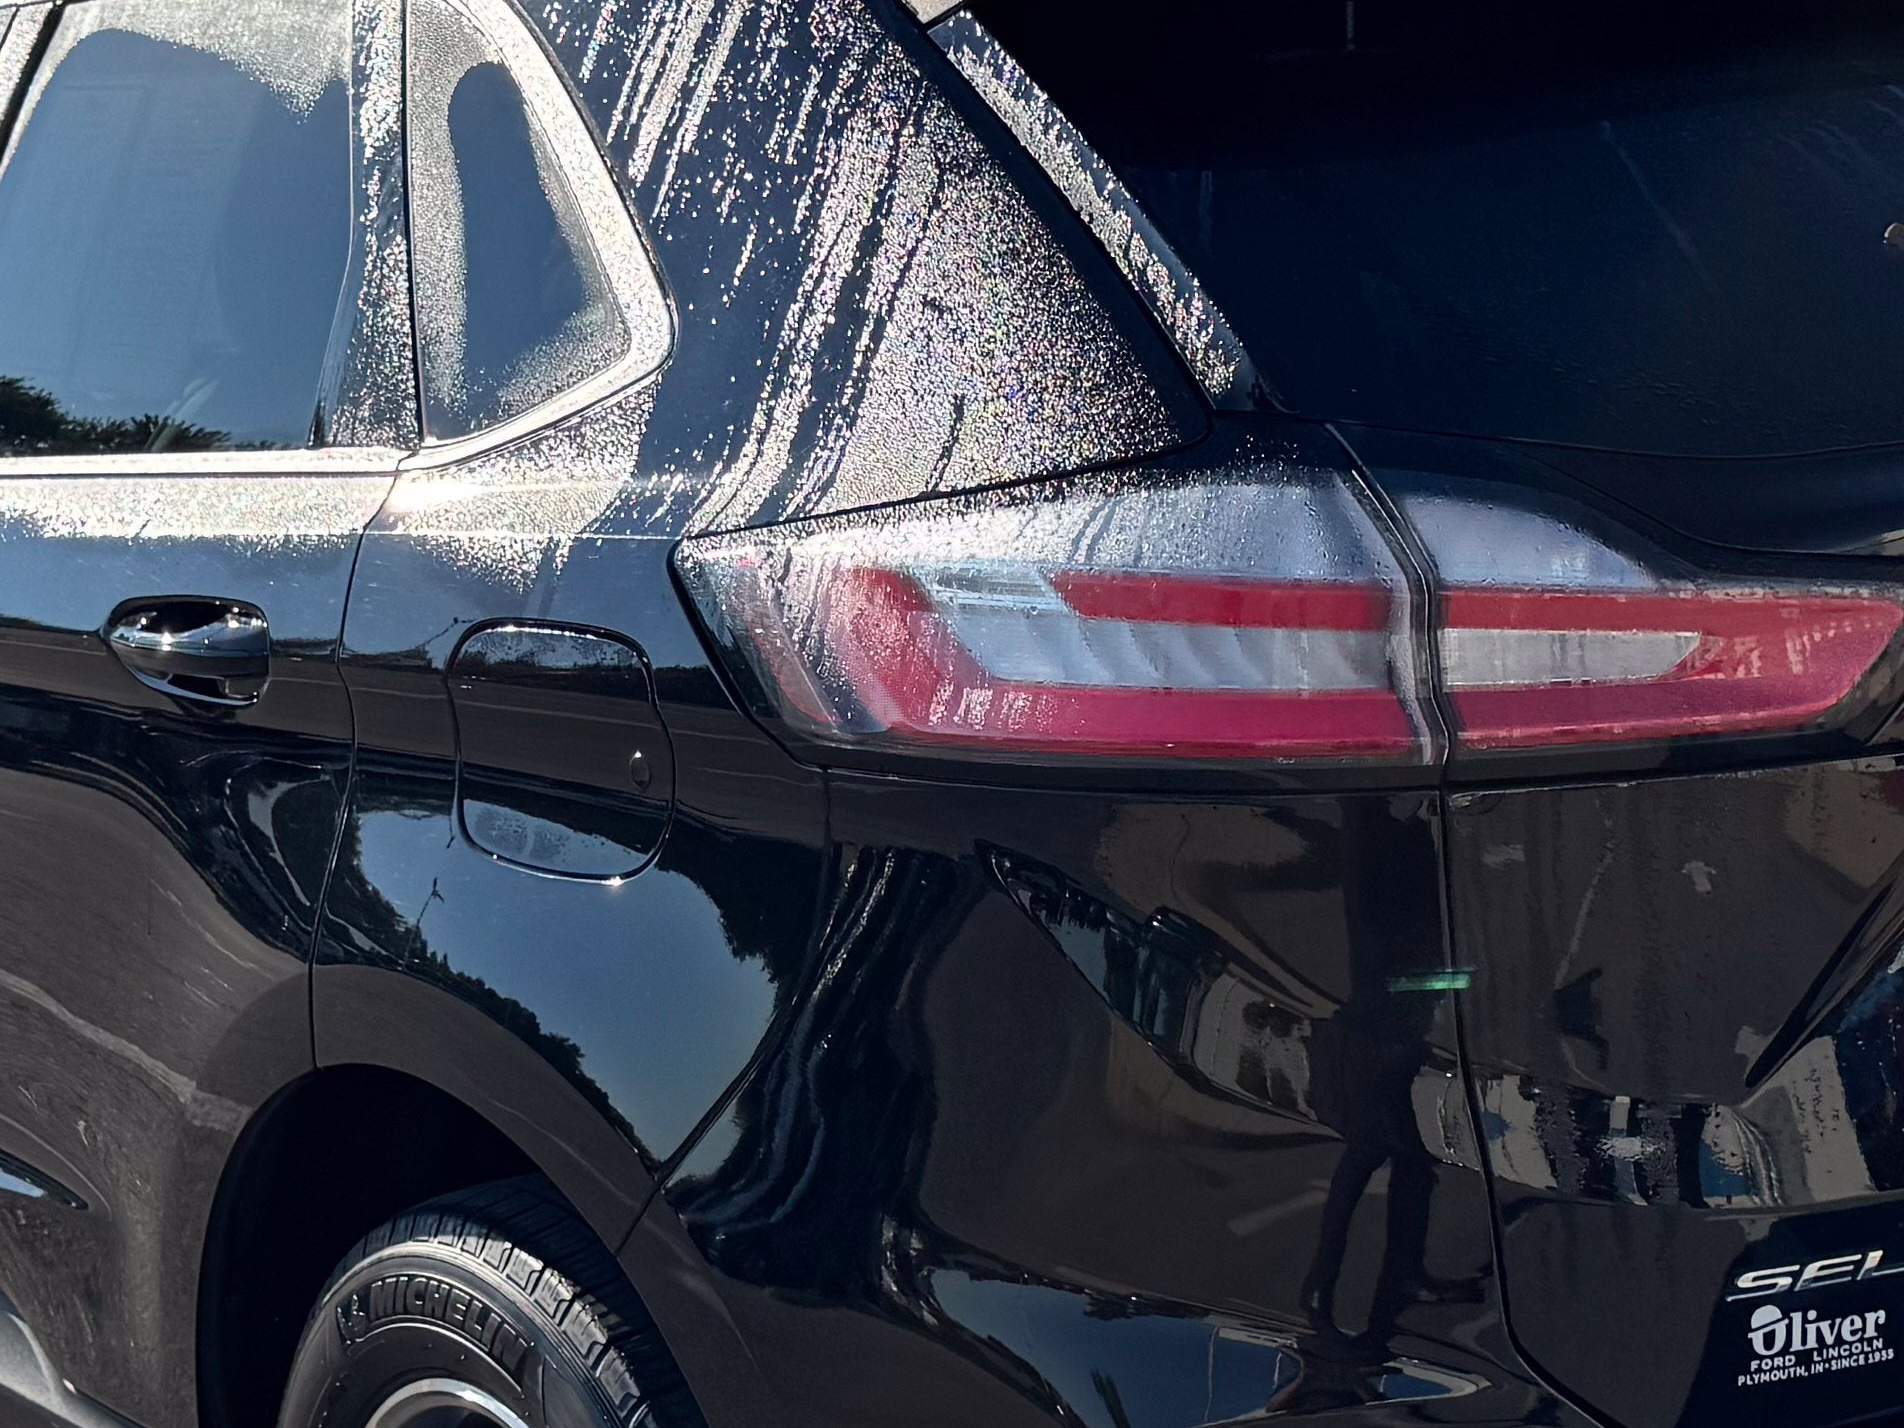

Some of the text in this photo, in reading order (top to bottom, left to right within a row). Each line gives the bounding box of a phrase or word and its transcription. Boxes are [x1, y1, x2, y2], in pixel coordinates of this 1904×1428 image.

[369, 1276, 530, 1380] MICHELIN
[1747, 1304, 1886, 1356] Oliver
[1737, 1366, 1809, 1386] PLYMOUTH,
[1750, 1337, 1883, 1372] FORD LINCOLN
